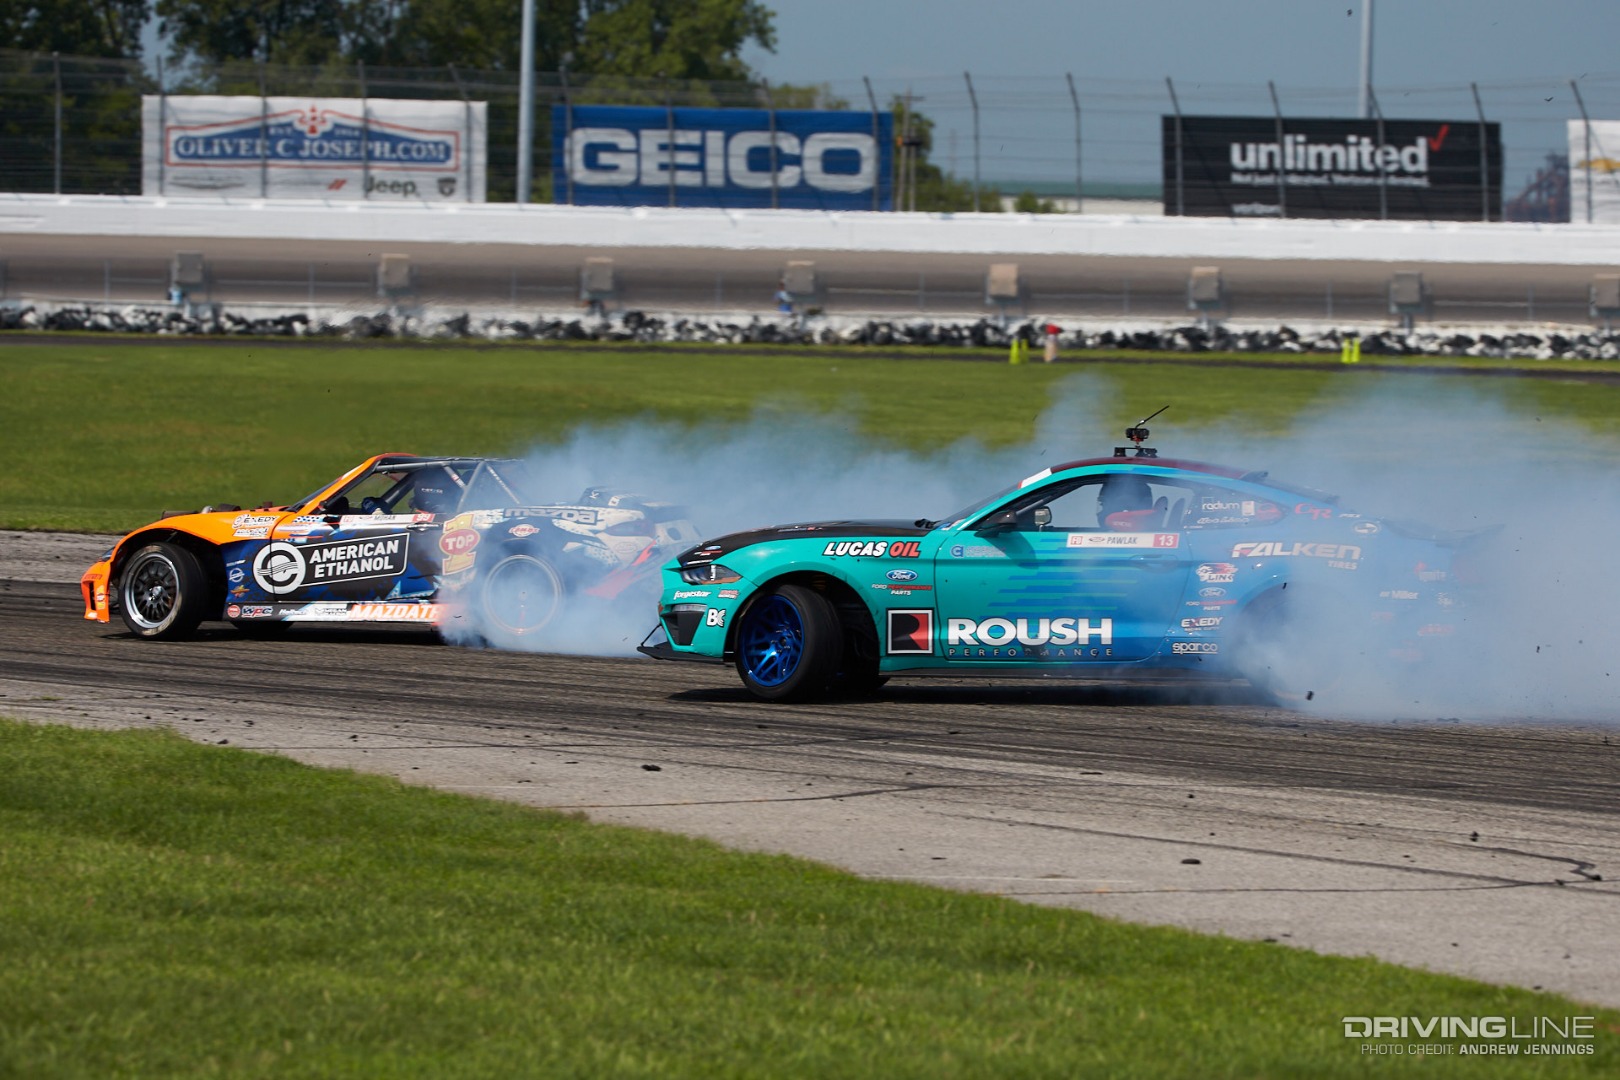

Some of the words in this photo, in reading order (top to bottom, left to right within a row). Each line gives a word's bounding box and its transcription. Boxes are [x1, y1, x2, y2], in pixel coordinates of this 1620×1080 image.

[178, 138, 272, 156] OLIVER
[277, 139, 296, 158] C
[299, 139, 446, 161] JOSEPH.COM
[1230, 134, 1429, 173] unlimited
[564, 127, 878, 194] GEICO
[366, 176, 416, 197] Jeep
[445, 534, 475, 551] TOP
[823, 541, 888, 558] LUCAS
[889, 541, 922, 558] OIL
[1106, 536, 1138, 545] PAWLAK
[1159, 535, 1174, 547] 13
[309, 539, 399, 564] AMERICAN
[1231, 542, 1362, 560] FALKEN
[314, 555, 394, 579] ETHANOL
[1328, 560, 1358, 570] TIRES
[892, 570, 912, 580] Ford
[1181, 617, 1224, 628] EXEDY
[947, 617, 1114, 647] ROUSH
[1172, 642, 1218, 655] sparco
